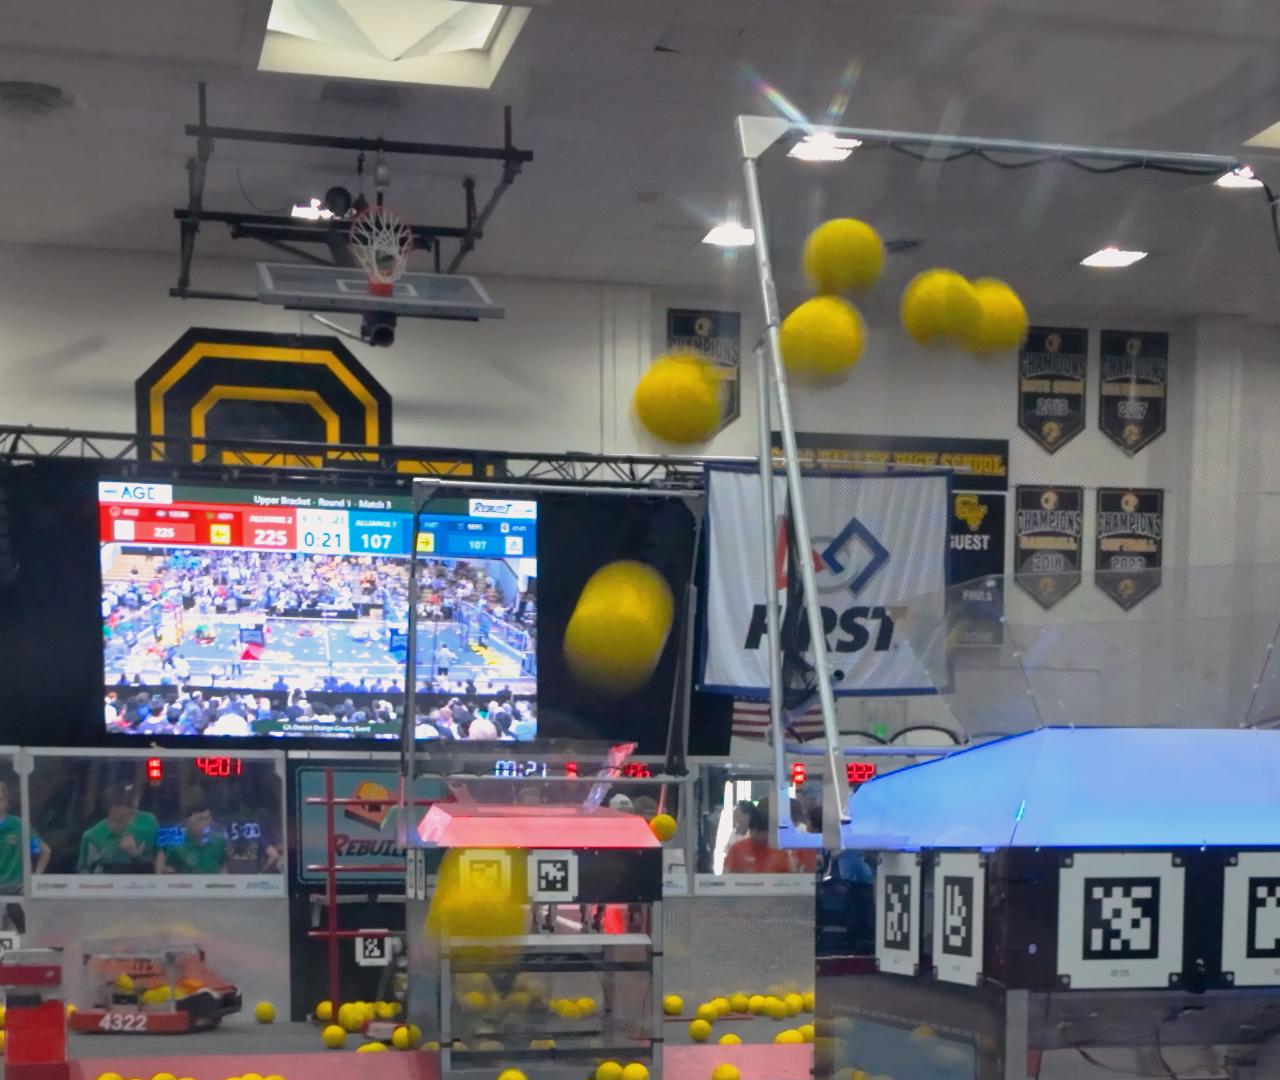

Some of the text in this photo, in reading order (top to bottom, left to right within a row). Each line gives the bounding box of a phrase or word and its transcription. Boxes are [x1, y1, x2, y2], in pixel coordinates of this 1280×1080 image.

[940, 452, 1006, 476] SCHOOL
[153, 528, 175, 538] 225
[1016, 509, 1081, 538] CHAMPIONS
[1097, 512, 1162, 540] CHAMPIONS
[254, 529, 288, 546] 225
[361, 533, 392, 549] 107
[1032, 553, 1063, 571] 2018
[744, 604, 909, 652] FRST
[195, 756, 243, 776] 4201
[99, 1014, 148, 1032] 4322
